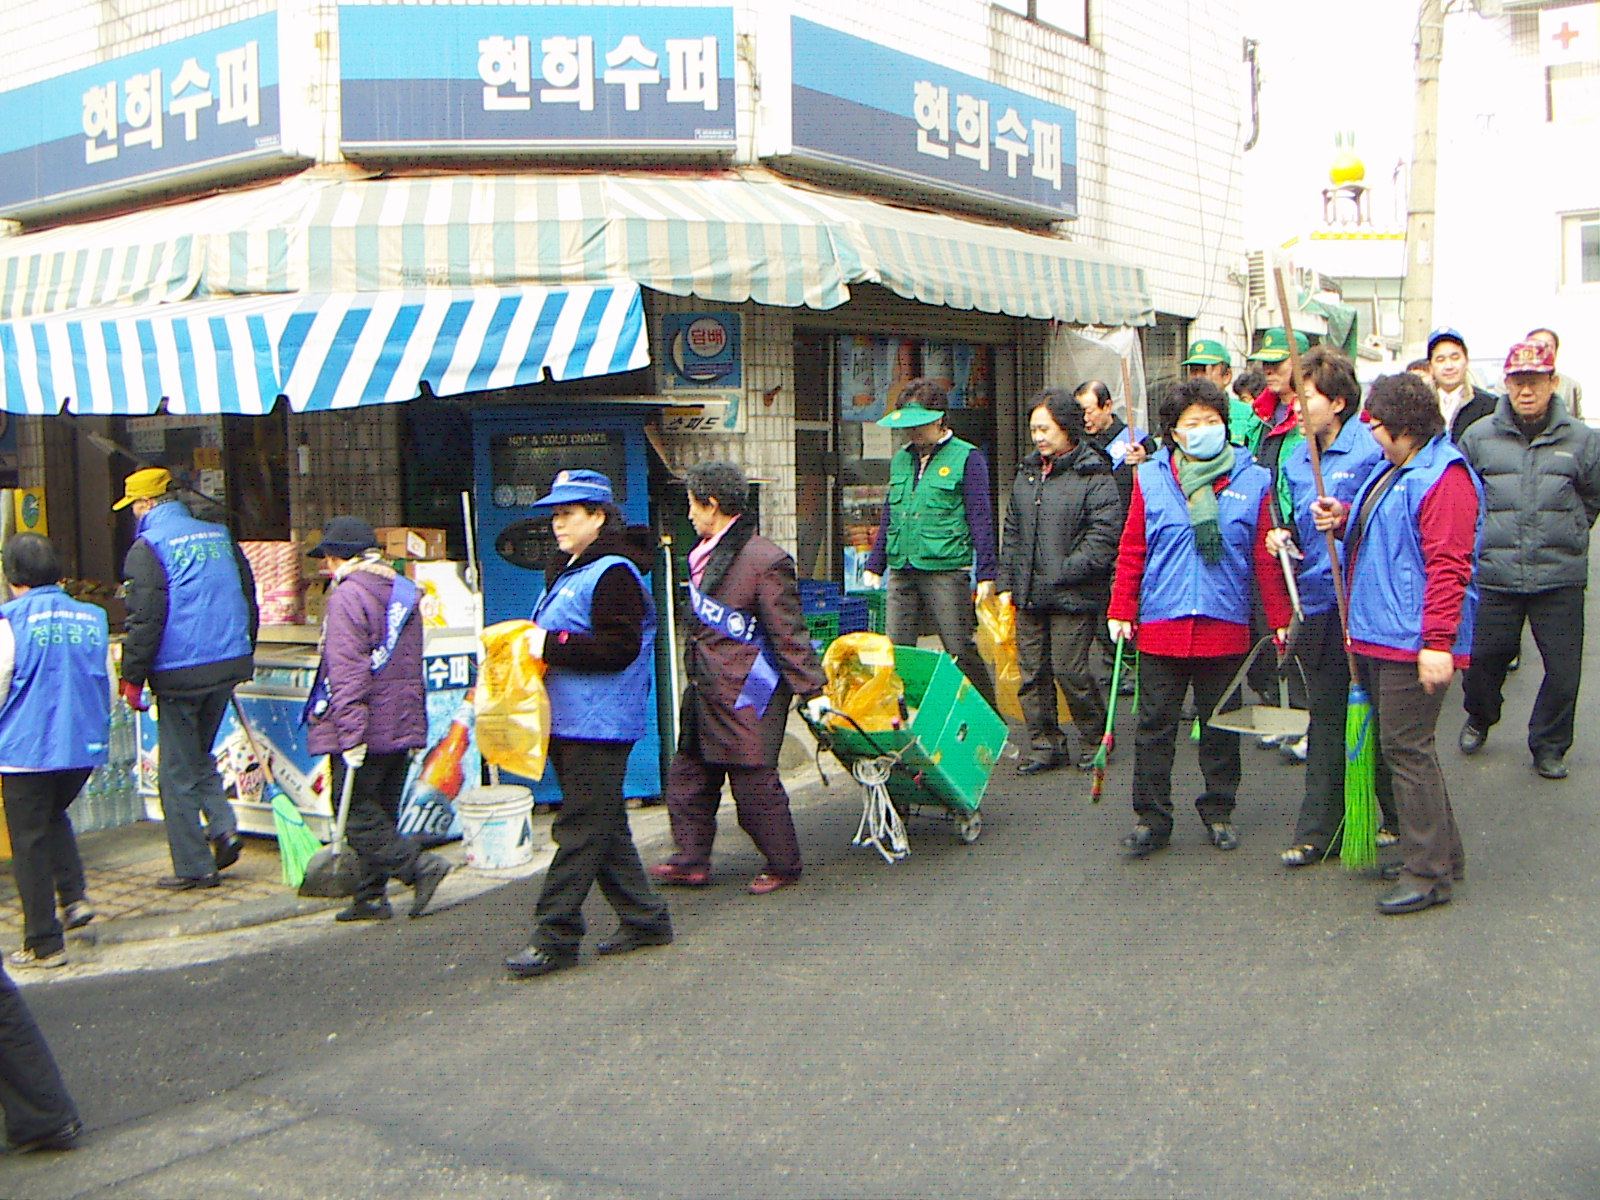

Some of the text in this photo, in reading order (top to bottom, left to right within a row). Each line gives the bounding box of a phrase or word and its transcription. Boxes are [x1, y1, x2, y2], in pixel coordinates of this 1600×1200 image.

[82, 40, 260, 165] 현희수퍼
[477, 35, 719, 111] 현희수퍼
[913, 80, 1062, 191] 현희수퍼
[423, 655, 470, 689] 수퍼
[397, 795, 454, 835] hite
